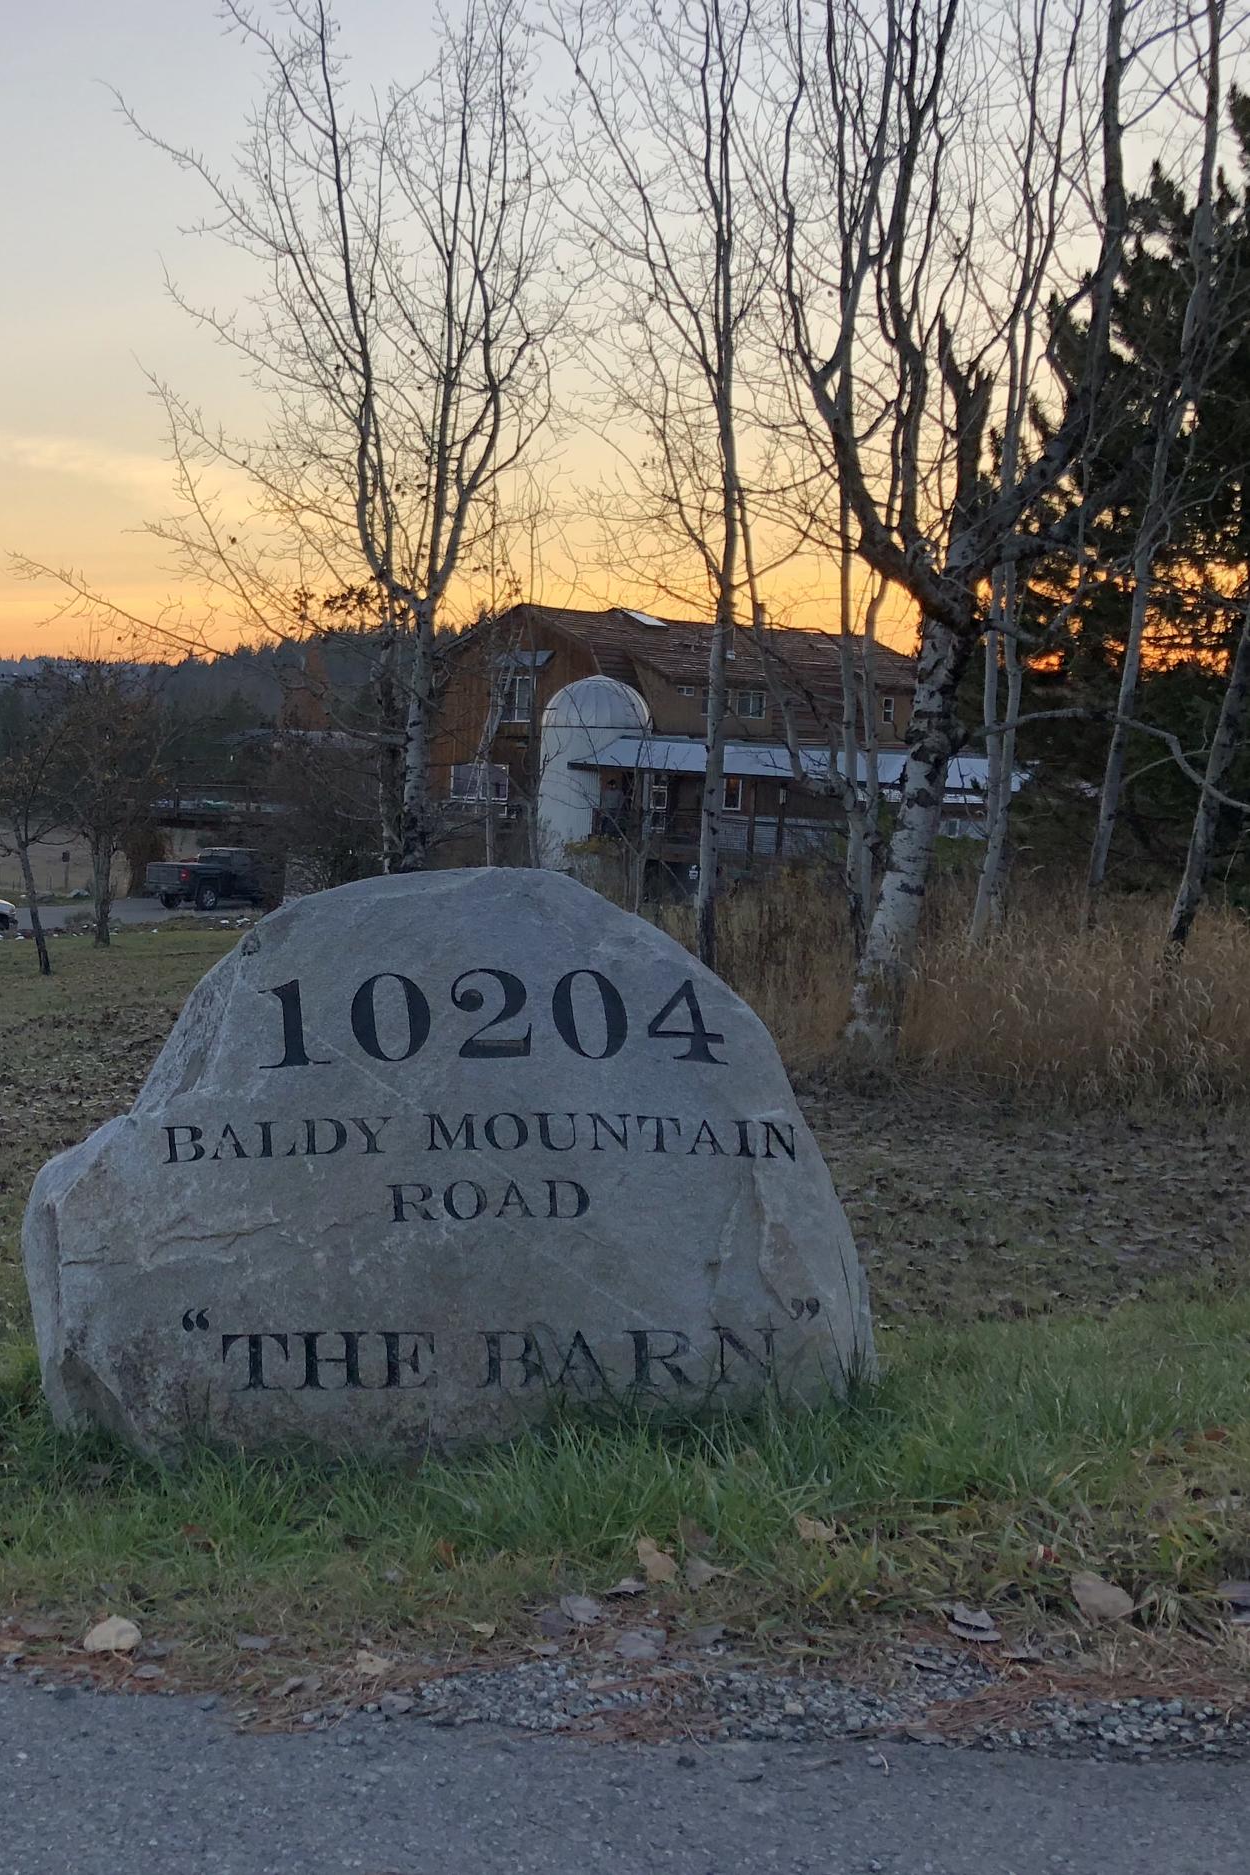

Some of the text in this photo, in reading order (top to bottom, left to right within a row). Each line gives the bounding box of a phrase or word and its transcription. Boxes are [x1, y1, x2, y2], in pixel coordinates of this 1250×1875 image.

[259, 968, 728, 1069] 10204
[162, 1112, 797, 1164] BALDY MOUNTAIN
[390, 1179, 589, 1222] ROAD
